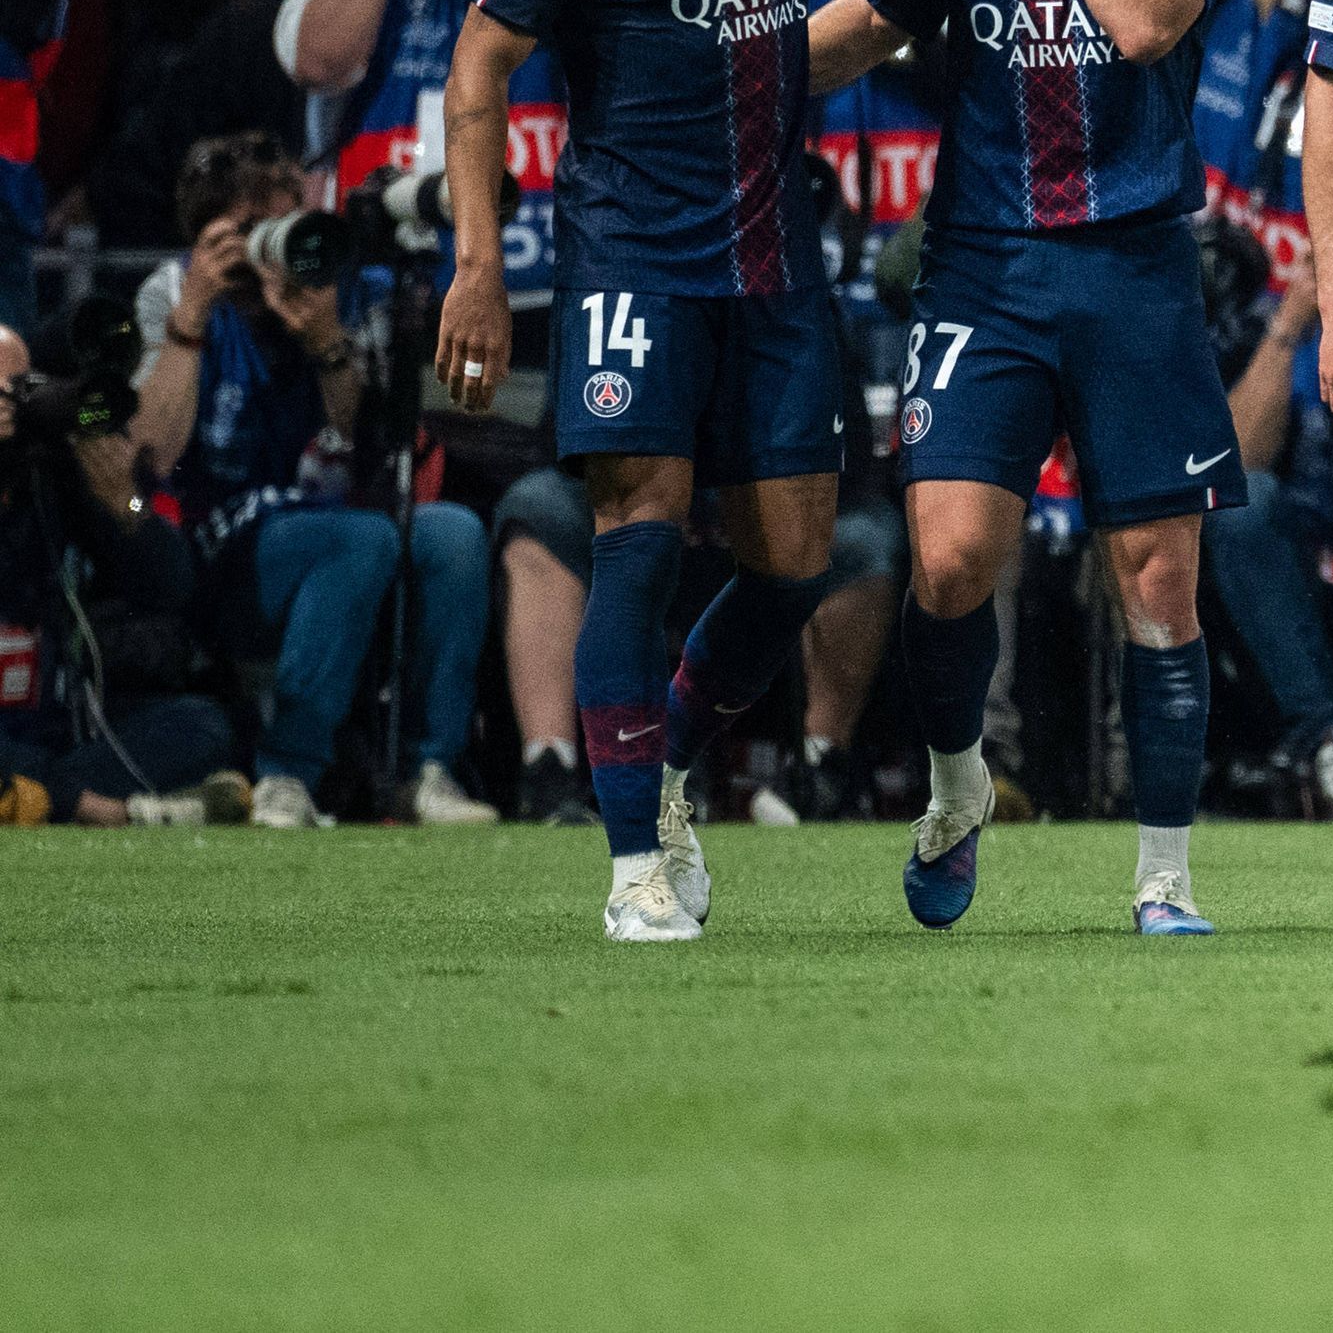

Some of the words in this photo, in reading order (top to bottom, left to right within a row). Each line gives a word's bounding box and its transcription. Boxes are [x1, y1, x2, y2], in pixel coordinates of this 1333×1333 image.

[970, 0, 1106, 52] QATA
[581, 292, 653, 368] 14
[902, 321, 975, 396] 87
[592, 375, 623, 386] PARIS
